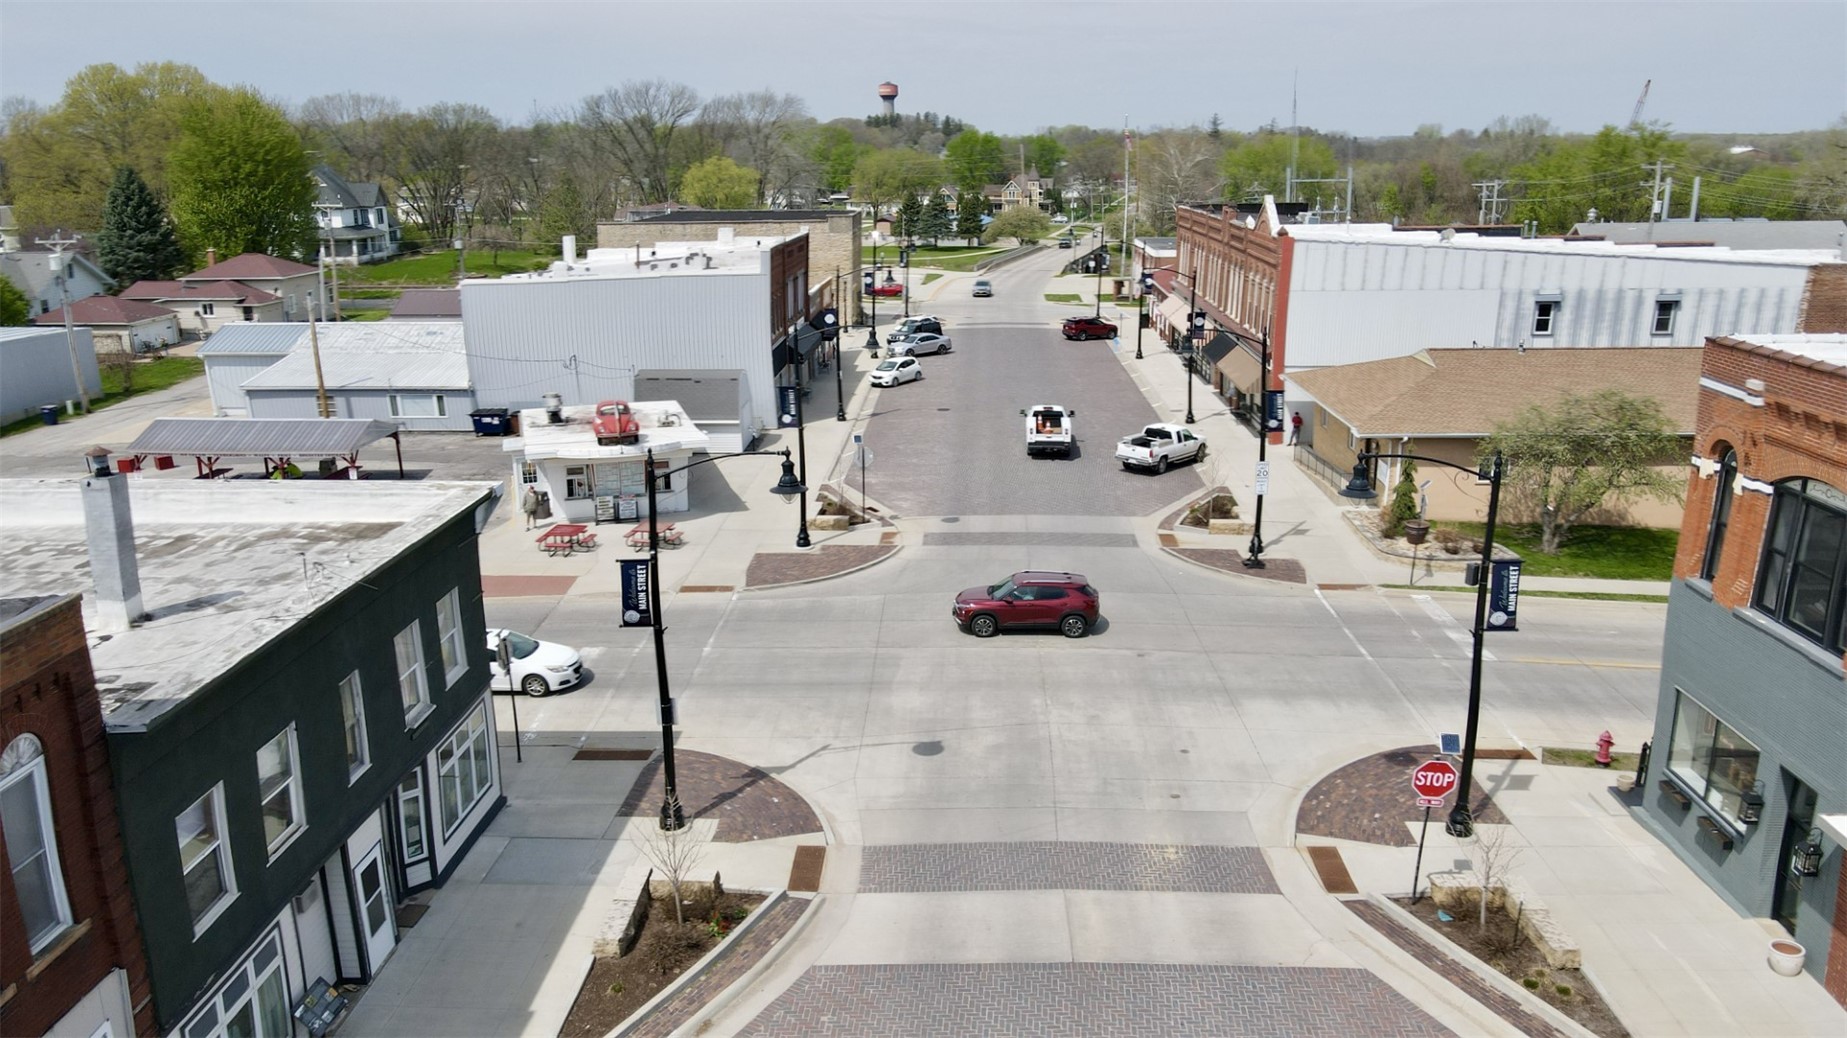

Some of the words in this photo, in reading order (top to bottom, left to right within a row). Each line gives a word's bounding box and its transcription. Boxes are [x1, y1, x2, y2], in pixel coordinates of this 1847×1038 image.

[637, 565, 646, 591] STREET
[1509, 566, 1519, 592] STREET
[638, 592, 647, 609] MAIN
[1508, 594, 1516, 611] MAIN
[1415, 771, 1454, 787] STOP
